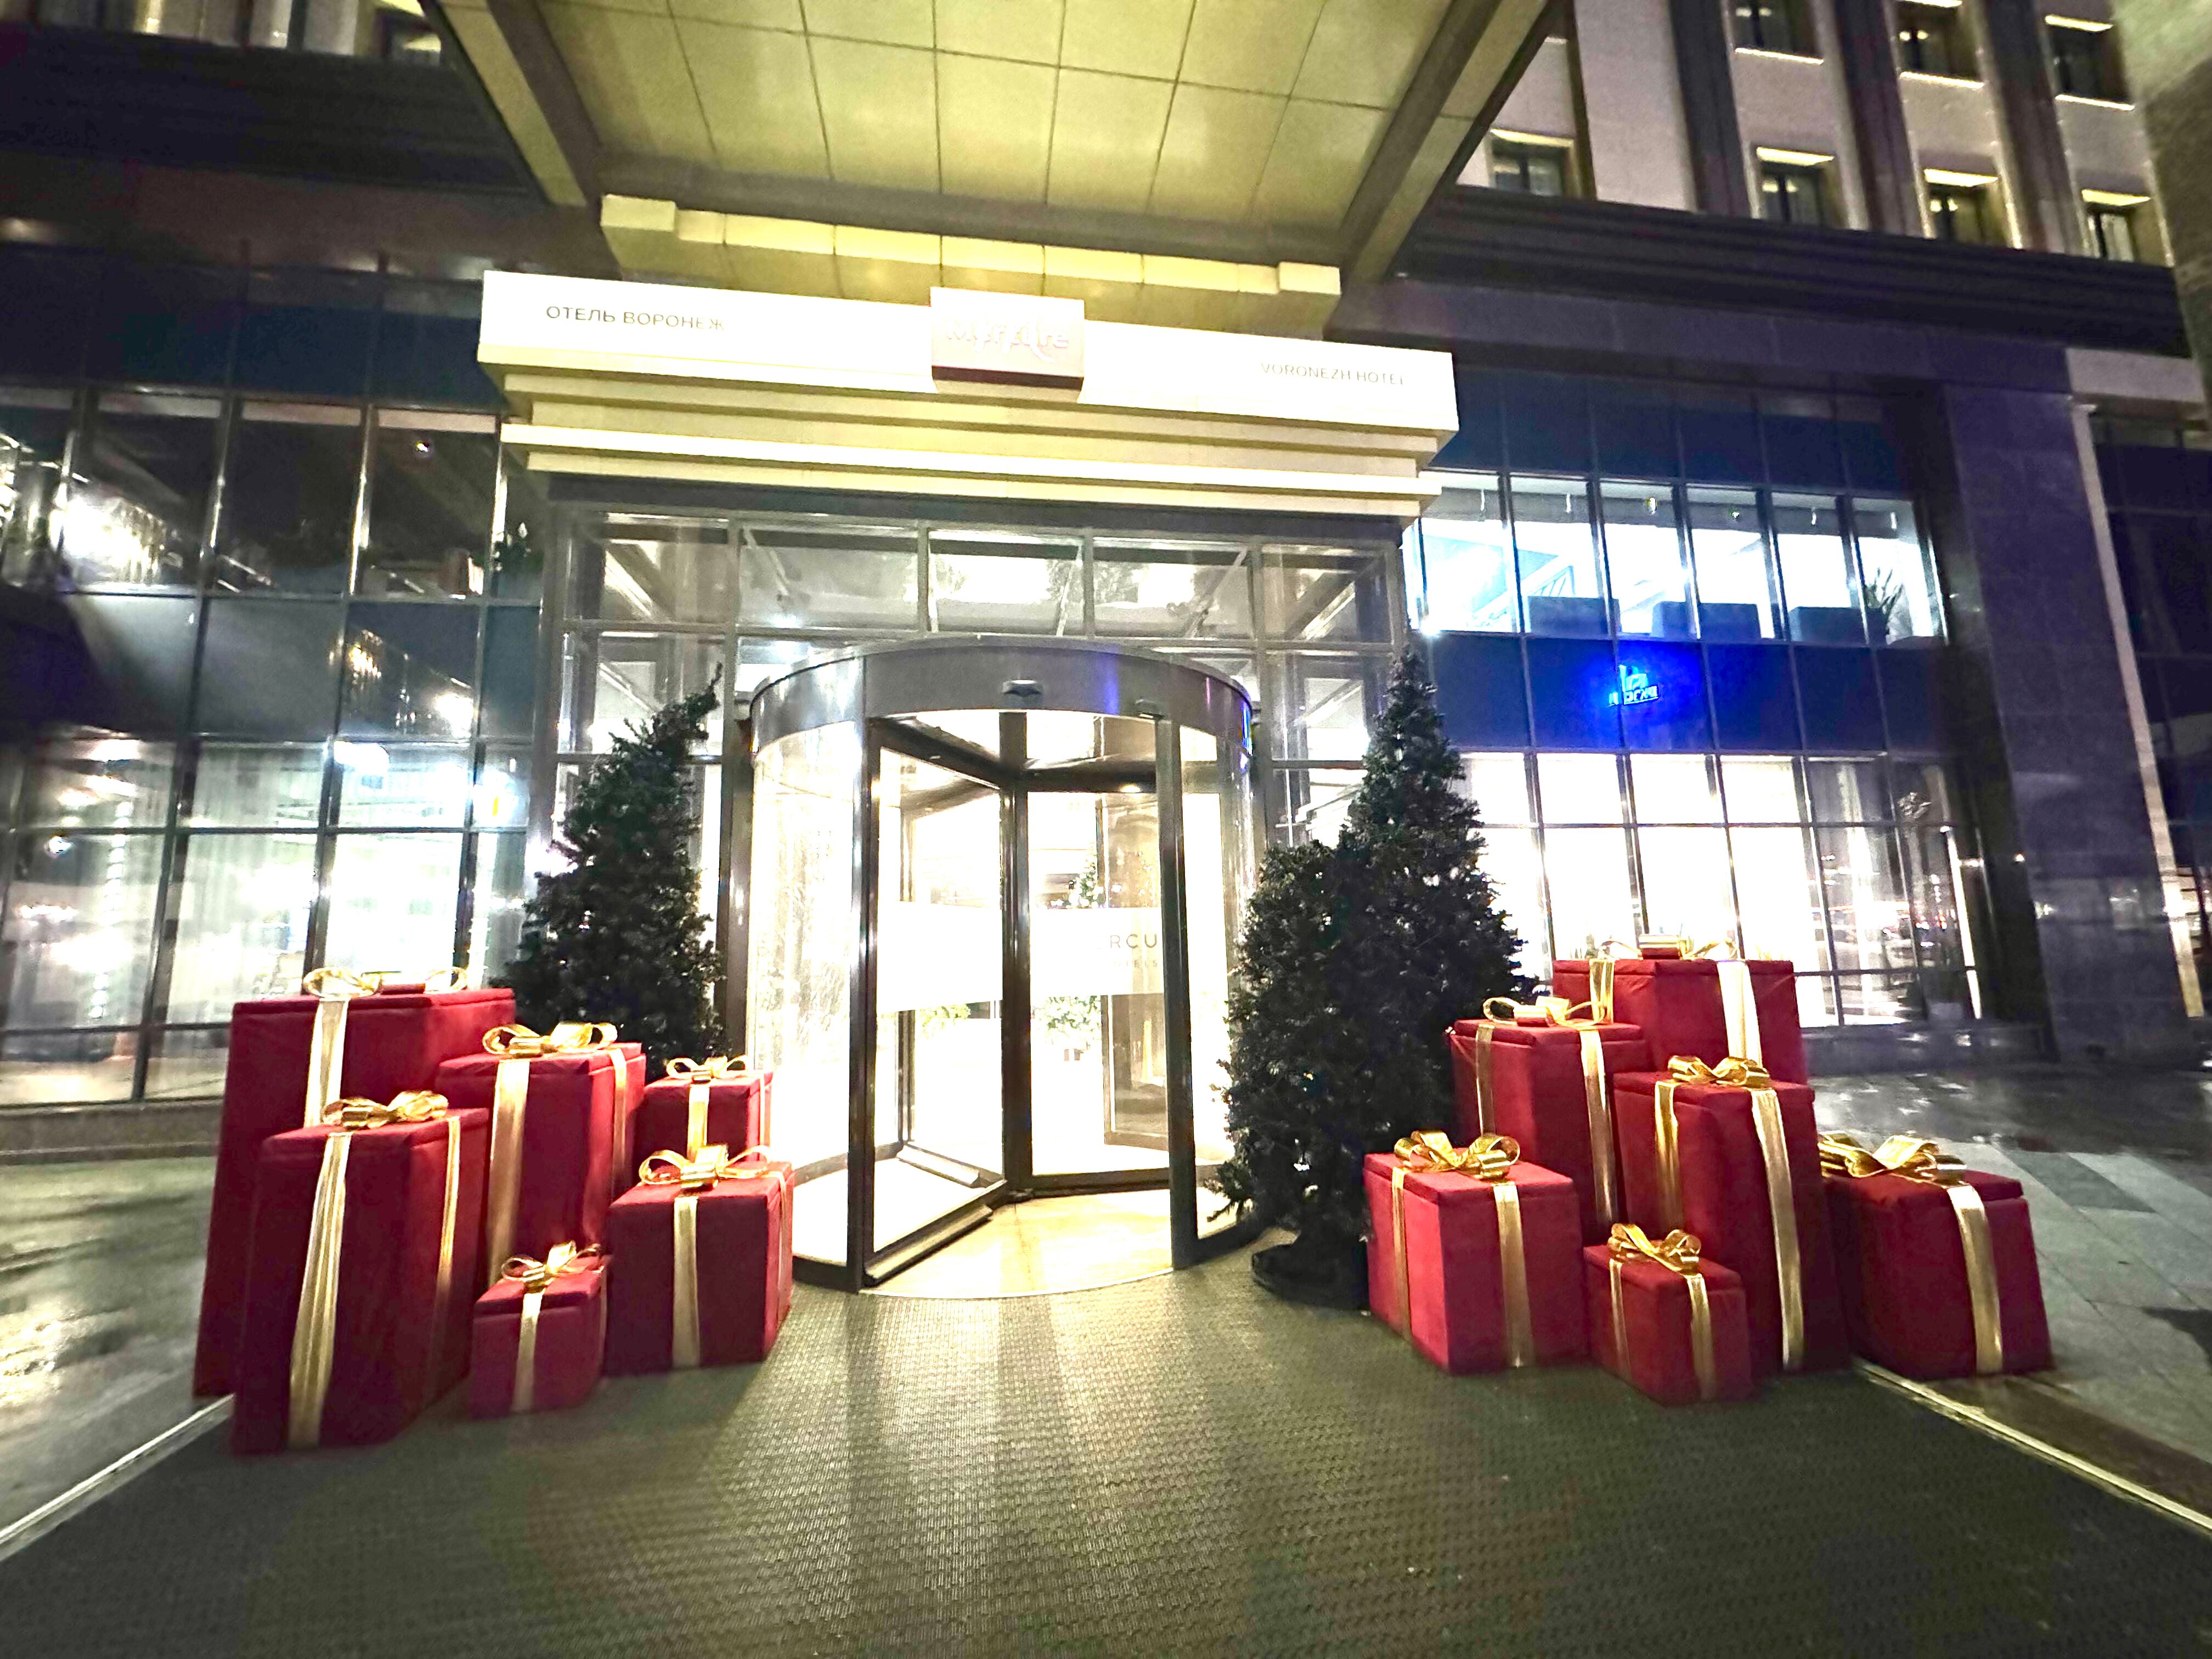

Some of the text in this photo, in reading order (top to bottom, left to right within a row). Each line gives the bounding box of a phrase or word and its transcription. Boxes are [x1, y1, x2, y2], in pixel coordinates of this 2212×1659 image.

[546, 306, 724, 331] ОТЕЛЬ ВОРОНЕЖ
[1261, 363, 1350, 380] VORONEZH
